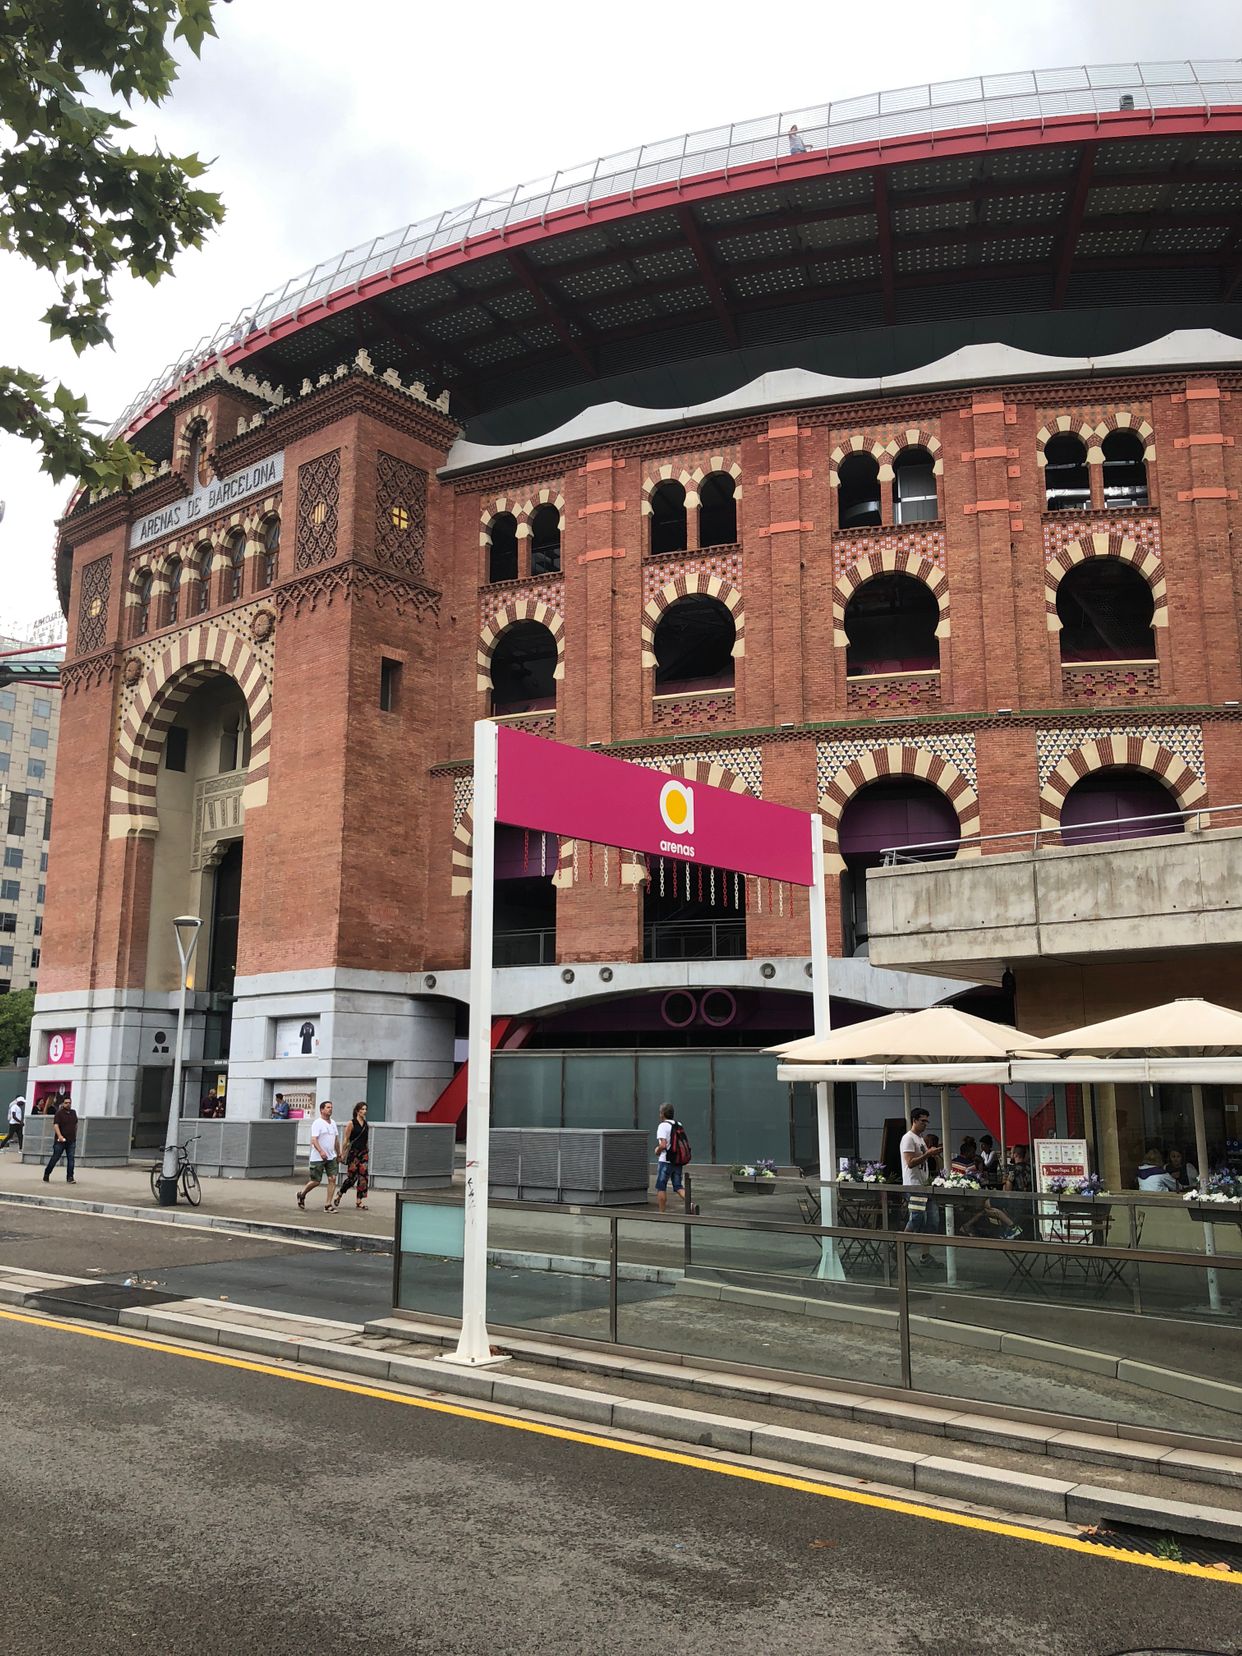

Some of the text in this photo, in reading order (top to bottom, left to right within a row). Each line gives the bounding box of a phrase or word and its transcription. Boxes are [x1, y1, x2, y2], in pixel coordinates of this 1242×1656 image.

[140, 460, 276, 541] ARENAS DE BARCELONA
[660, 839, 695, 858] arenas
